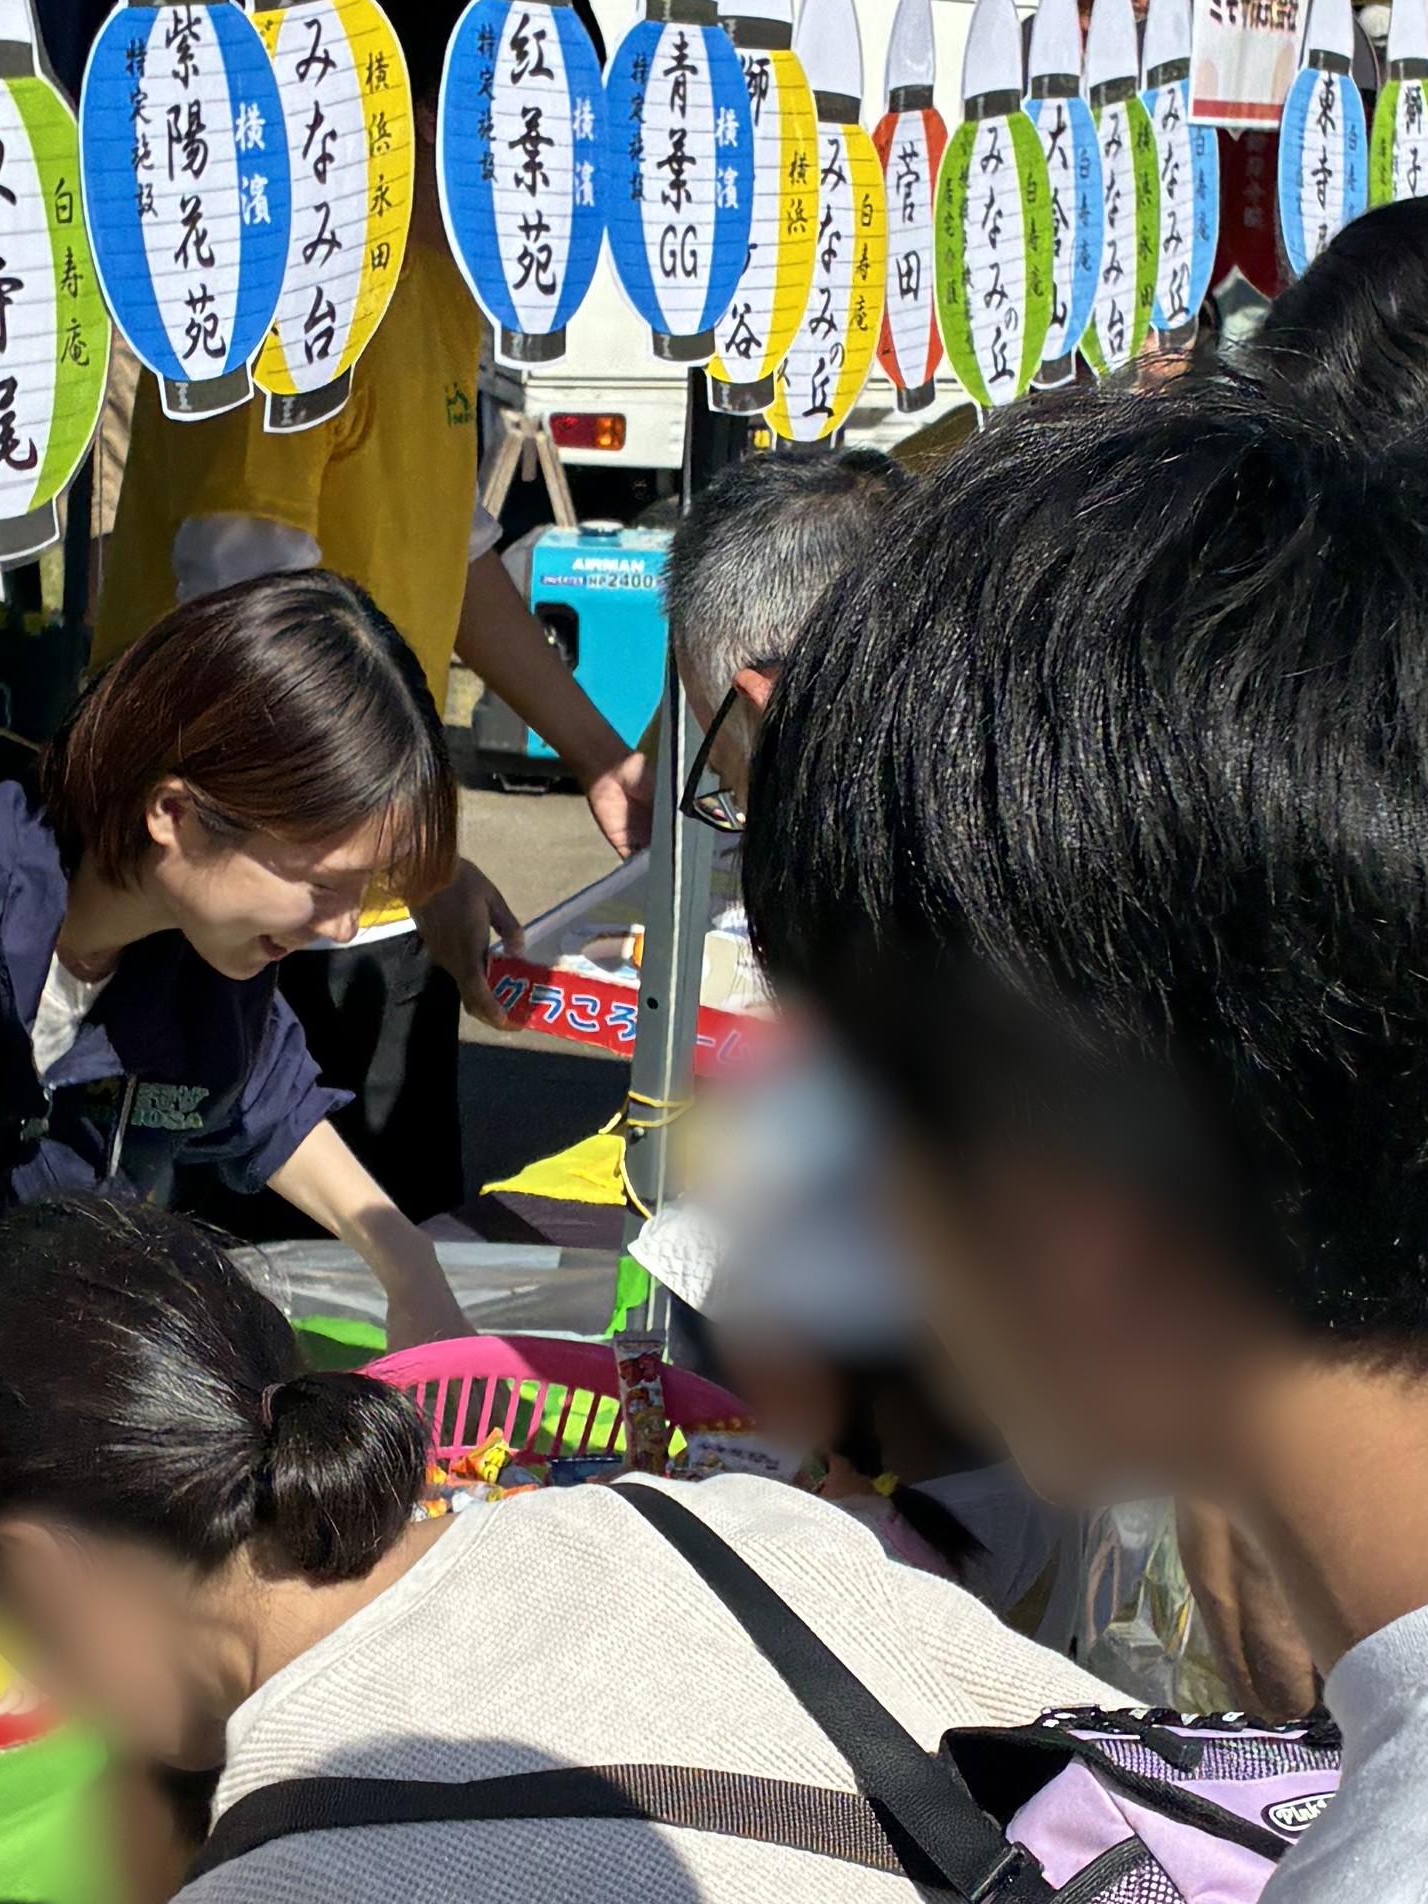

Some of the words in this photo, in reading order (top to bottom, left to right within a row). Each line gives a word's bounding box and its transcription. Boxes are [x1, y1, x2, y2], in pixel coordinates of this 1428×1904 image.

[165, 6, 227, 360] 紫陽花苑
[235, 102, 271, 226] 横濱
[295, 18, 343, 366] みなみ台
[510, 13, 557, 297] 紅葉苑
[572, 99, 596, 209] 横濱
[715, 106, 740, 210] 横濱
[980, 125, 1019, 384] みなみの丘
[54, 177, 91, 368] 白寿庵
